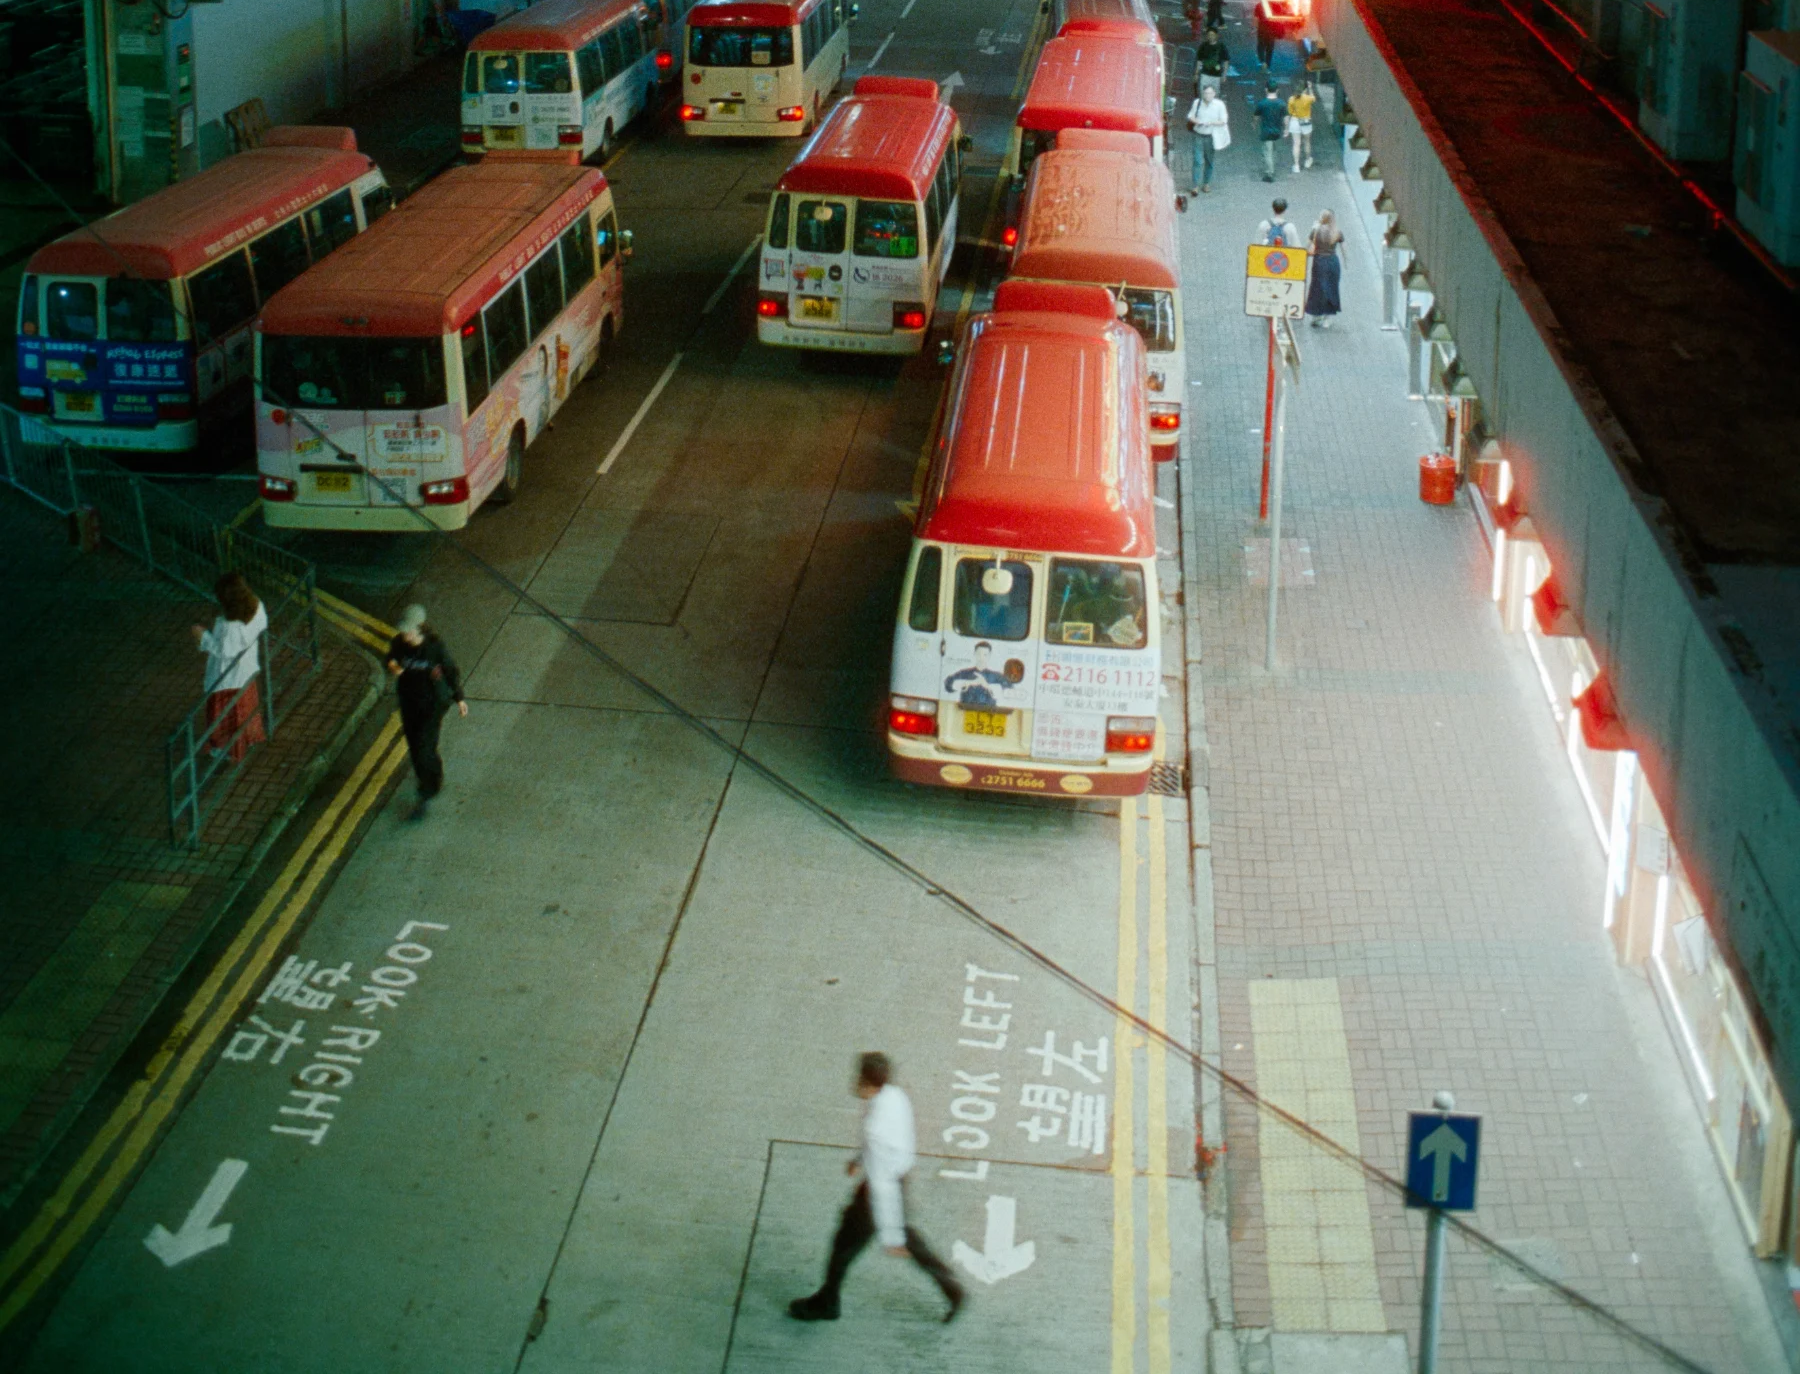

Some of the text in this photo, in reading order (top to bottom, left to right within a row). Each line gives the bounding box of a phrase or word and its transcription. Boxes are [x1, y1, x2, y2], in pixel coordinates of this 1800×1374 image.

[1283, 282, 1293, 295] 7
[1064, 666, 1155, 687] 2116 1112
[270, 920, 449, 1146] LOOK RIGHT
[939, 962, 1020, 1182] LOOK LEFT
[1016, 1030, 1109, 1155] 望左
